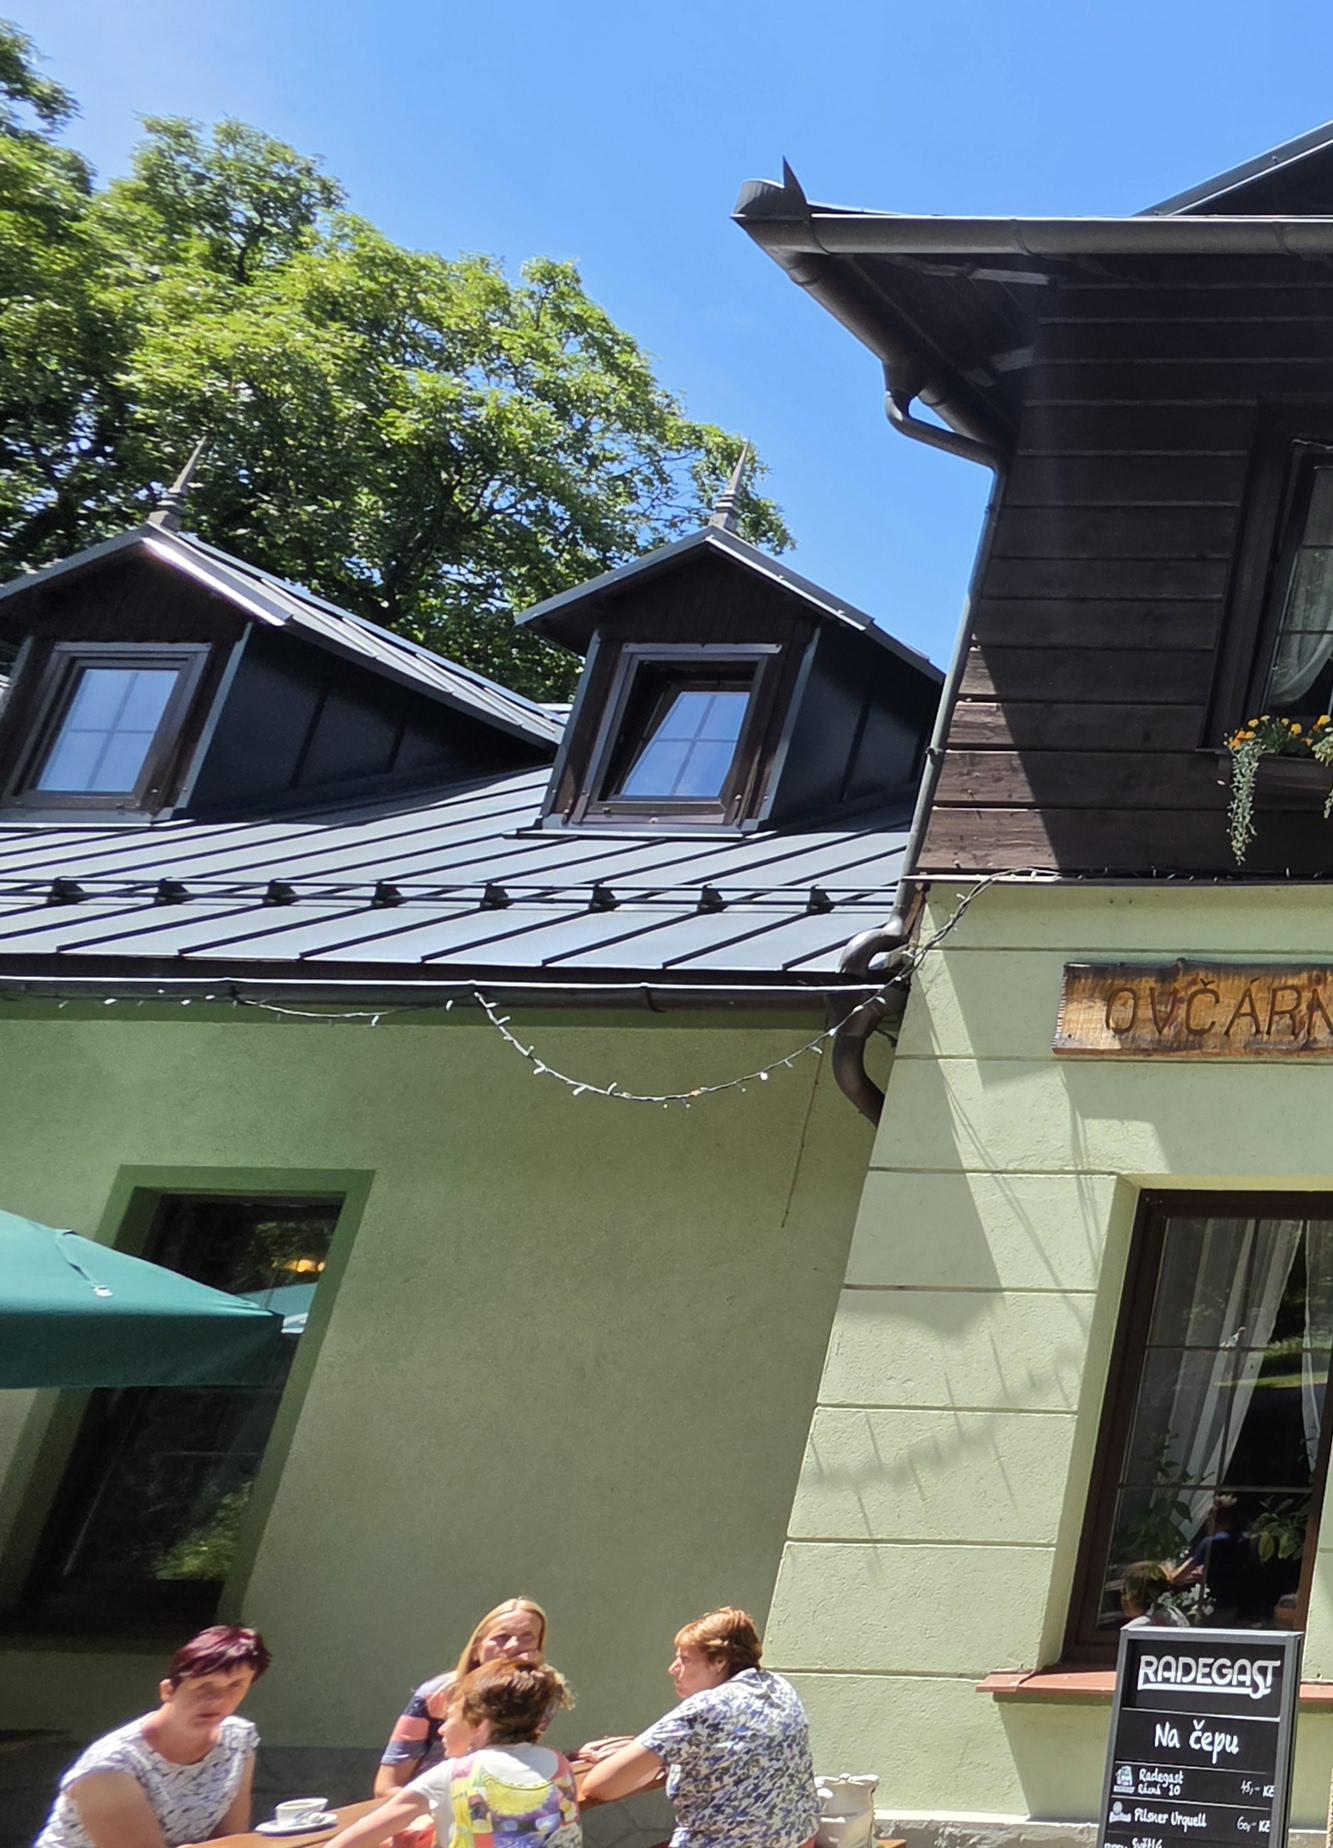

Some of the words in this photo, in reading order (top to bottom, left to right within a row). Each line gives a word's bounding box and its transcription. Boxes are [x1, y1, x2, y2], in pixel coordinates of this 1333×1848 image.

[1137, 1655, 1281, 1700] RADEGAST
[1154, 1722, 1180, 1749] Na
[1189, 1720, 1240, 1764] čepu
[1138, 1768, 1184, 1788] Radegast
[1134, 1808, 1169, 1825] Pilsner
[1170, 1811, 1207, 1833] Urquell
